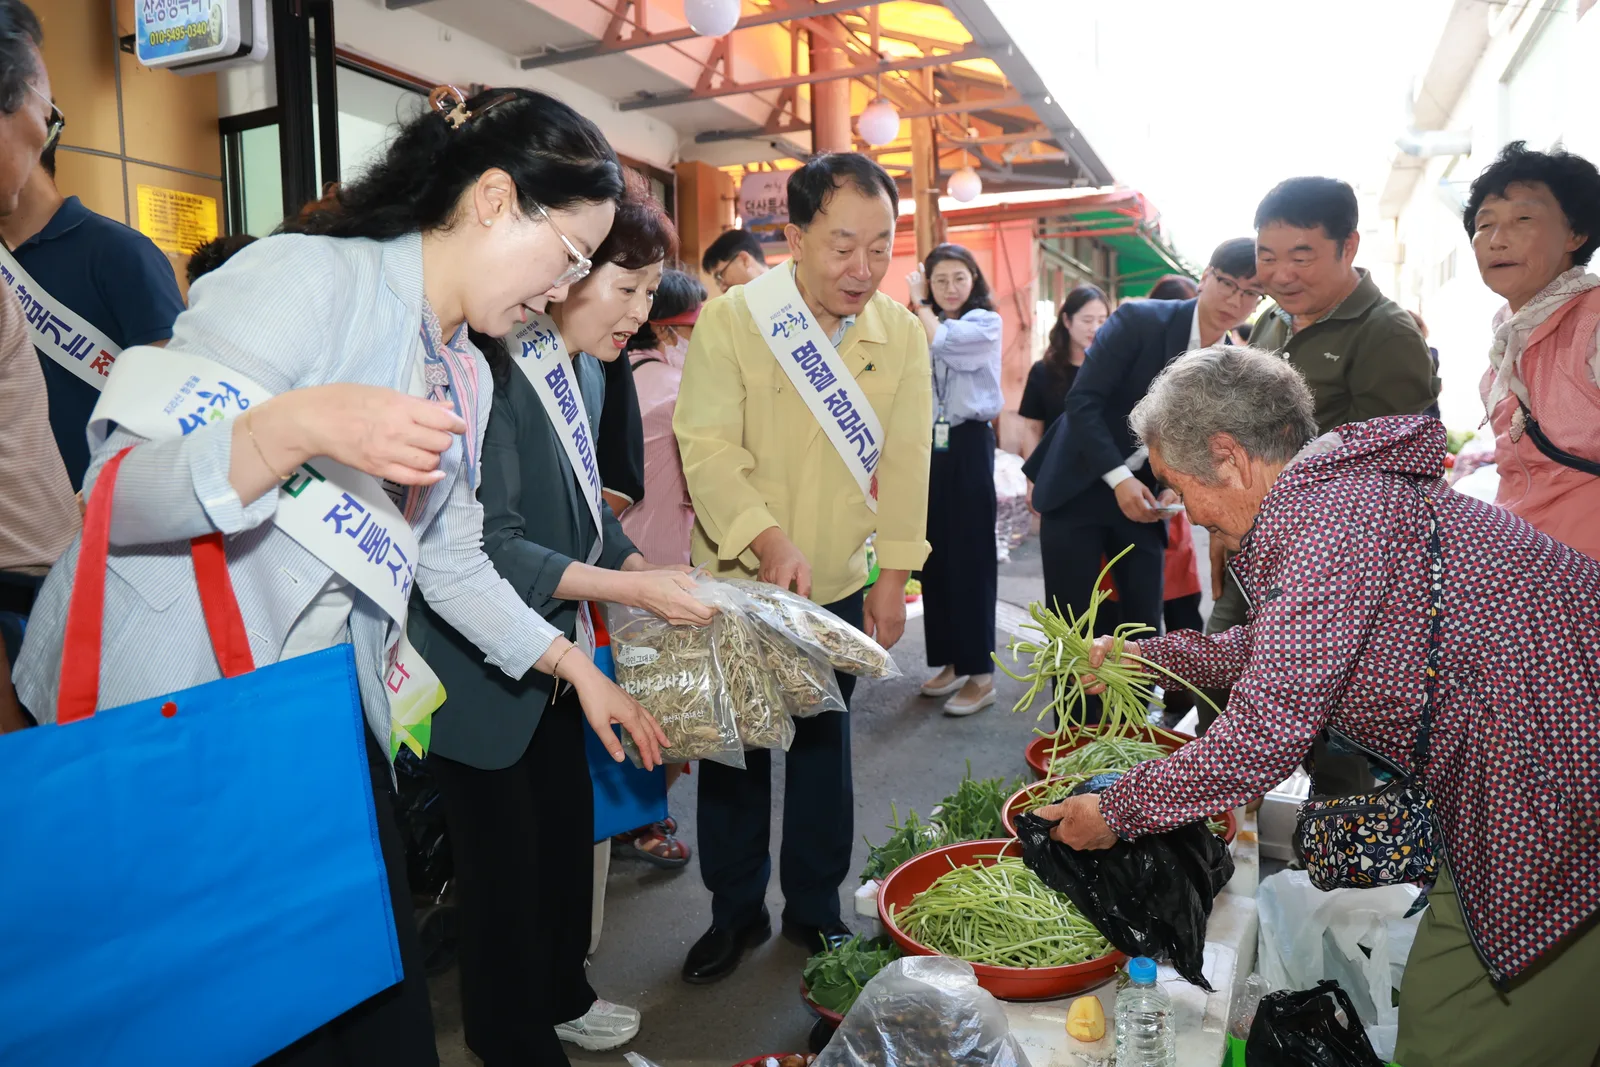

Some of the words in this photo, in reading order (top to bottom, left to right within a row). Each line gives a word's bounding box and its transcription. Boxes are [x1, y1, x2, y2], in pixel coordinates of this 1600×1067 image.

[150, 21, 207, 46] 010-5495-0340
[545, 362, 579, 425] 명절
[572, 421, 600, 512] 장보기
[791, 340, 837, 393] 명절
[823, 388, 879, 474] 장보기는
